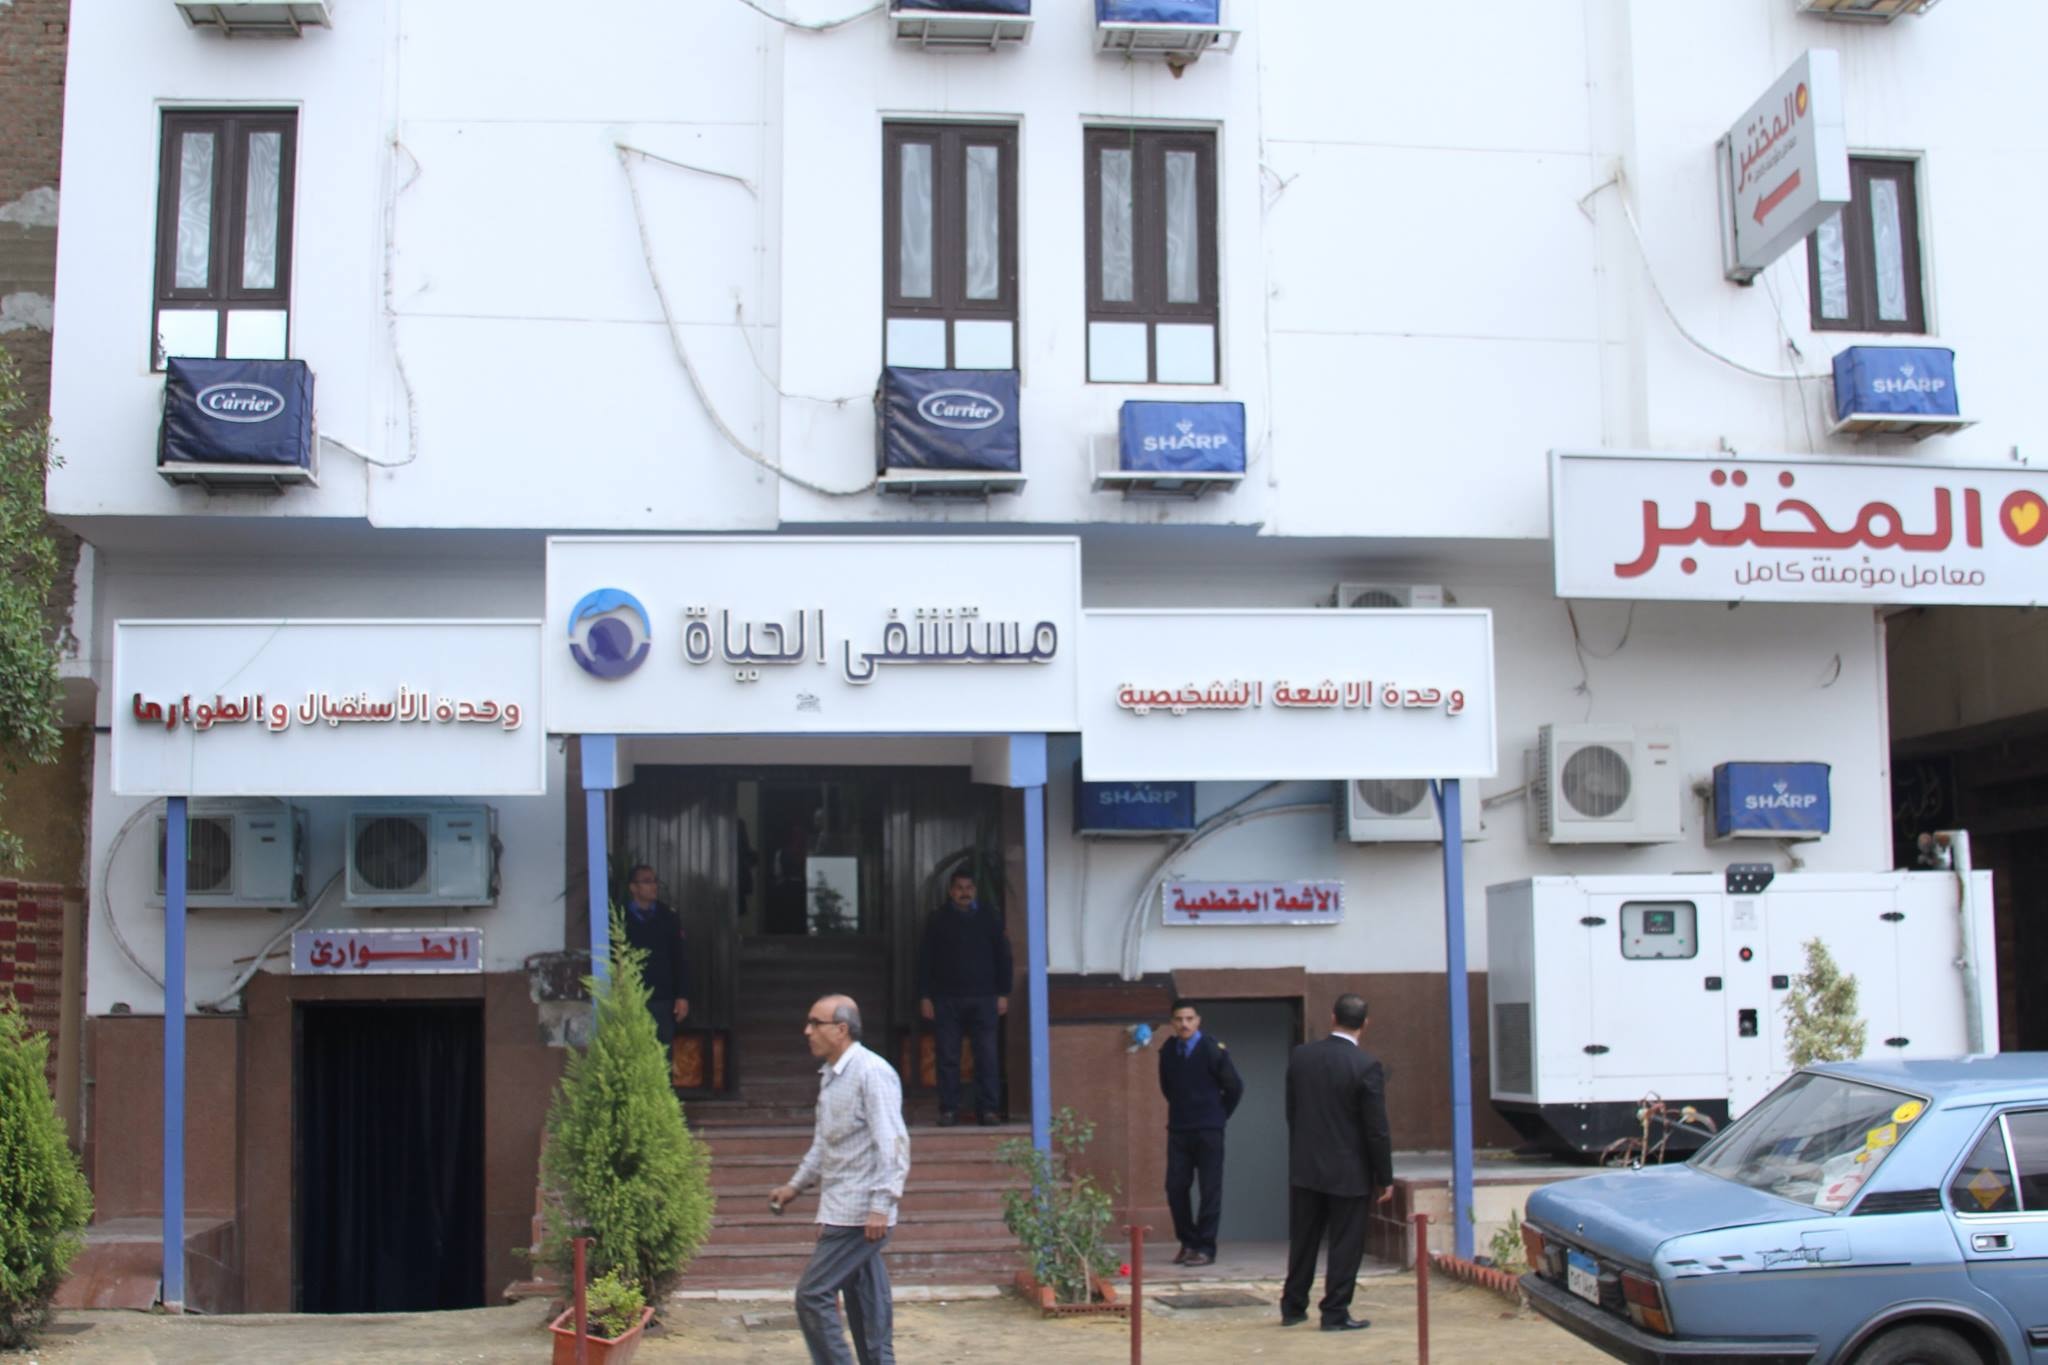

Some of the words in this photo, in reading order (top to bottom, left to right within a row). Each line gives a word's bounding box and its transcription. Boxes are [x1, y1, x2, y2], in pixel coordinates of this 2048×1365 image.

[1738, 91, 1795, 194] المختبر
[1872, 378, 1946, 393] SHARP
[209, 392, 273, 411] Carrier
[931, 400, 992, 419] Carrier
[1143, 433, 1227, 451] SHARP
[1614, 468, 1984, 579] المختبر
[1734, 560, 1805, 585] كامل
[1811, 556, 1895, 588] مؤمنة
[1900, 564, 1986, 588] معامل
[682, 606, 827, 682] الحياة
[842, 606, 1059, 685] مستشفى
[1118, 679, 1263, 715] التشخيصية
[1380, 681, 1466, 714] وحدة
[434, 696, 522, 730] وحدة
[1099, 788, 1178, 805] SHARP
[1744, 794, 1818, 809] SHARP
[1172, 888, 1269, 919] المقطعية
